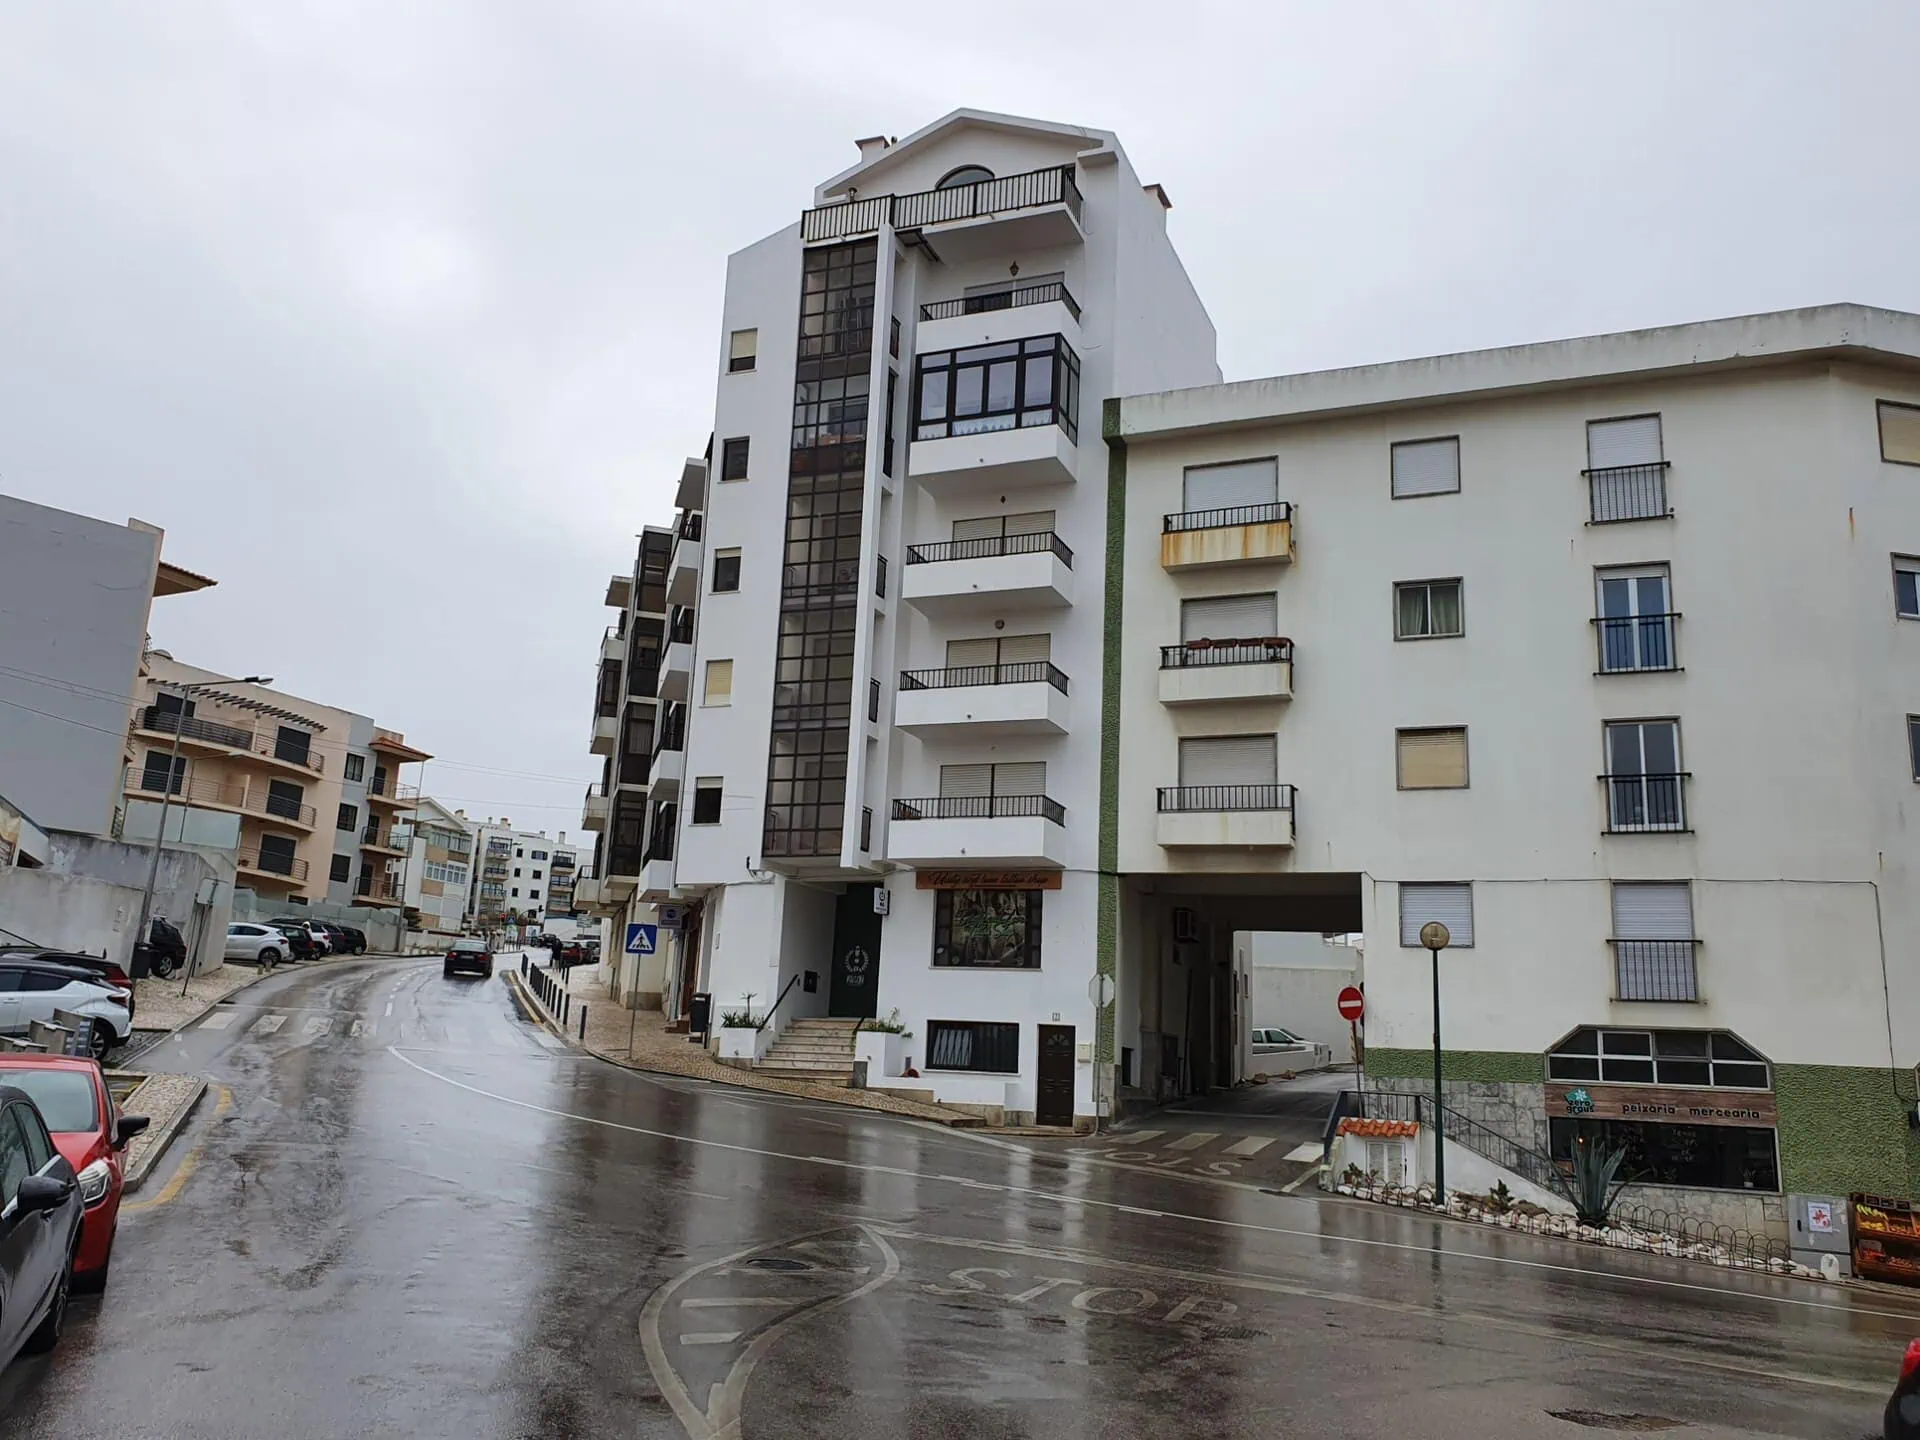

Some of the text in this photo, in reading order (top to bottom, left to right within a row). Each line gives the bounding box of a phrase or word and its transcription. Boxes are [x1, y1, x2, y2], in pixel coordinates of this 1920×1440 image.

[1567, 1099, 1591, 1107] zero
[1623, 1103, 1760, 1119] peixaria mercearia
[920, 1266, 1240, 1323] STOP
